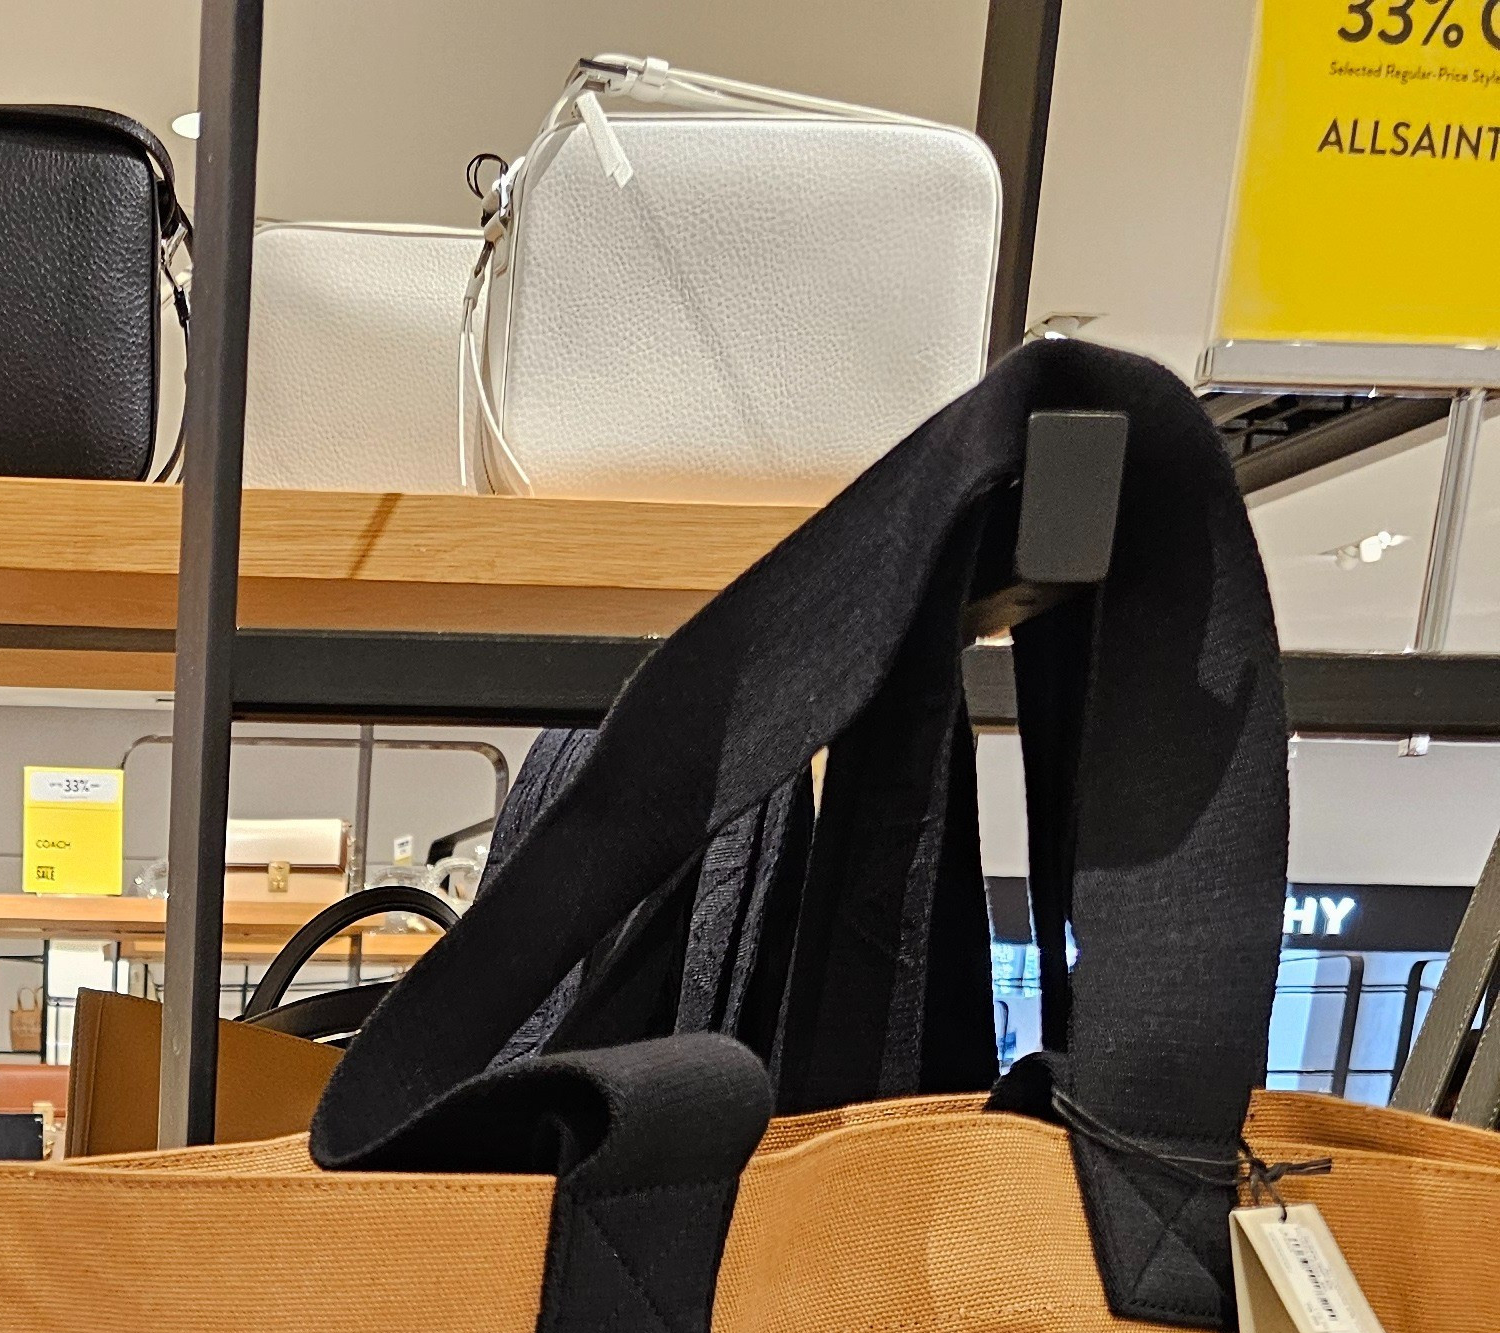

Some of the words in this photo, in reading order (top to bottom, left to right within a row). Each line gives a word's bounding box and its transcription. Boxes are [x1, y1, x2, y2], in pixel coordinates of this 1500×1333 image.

[1329, 60, 1383, 78] Selected
[1385, 64, 1469, 85] Regular-Price
[64, 779, 89, 792] 33%
